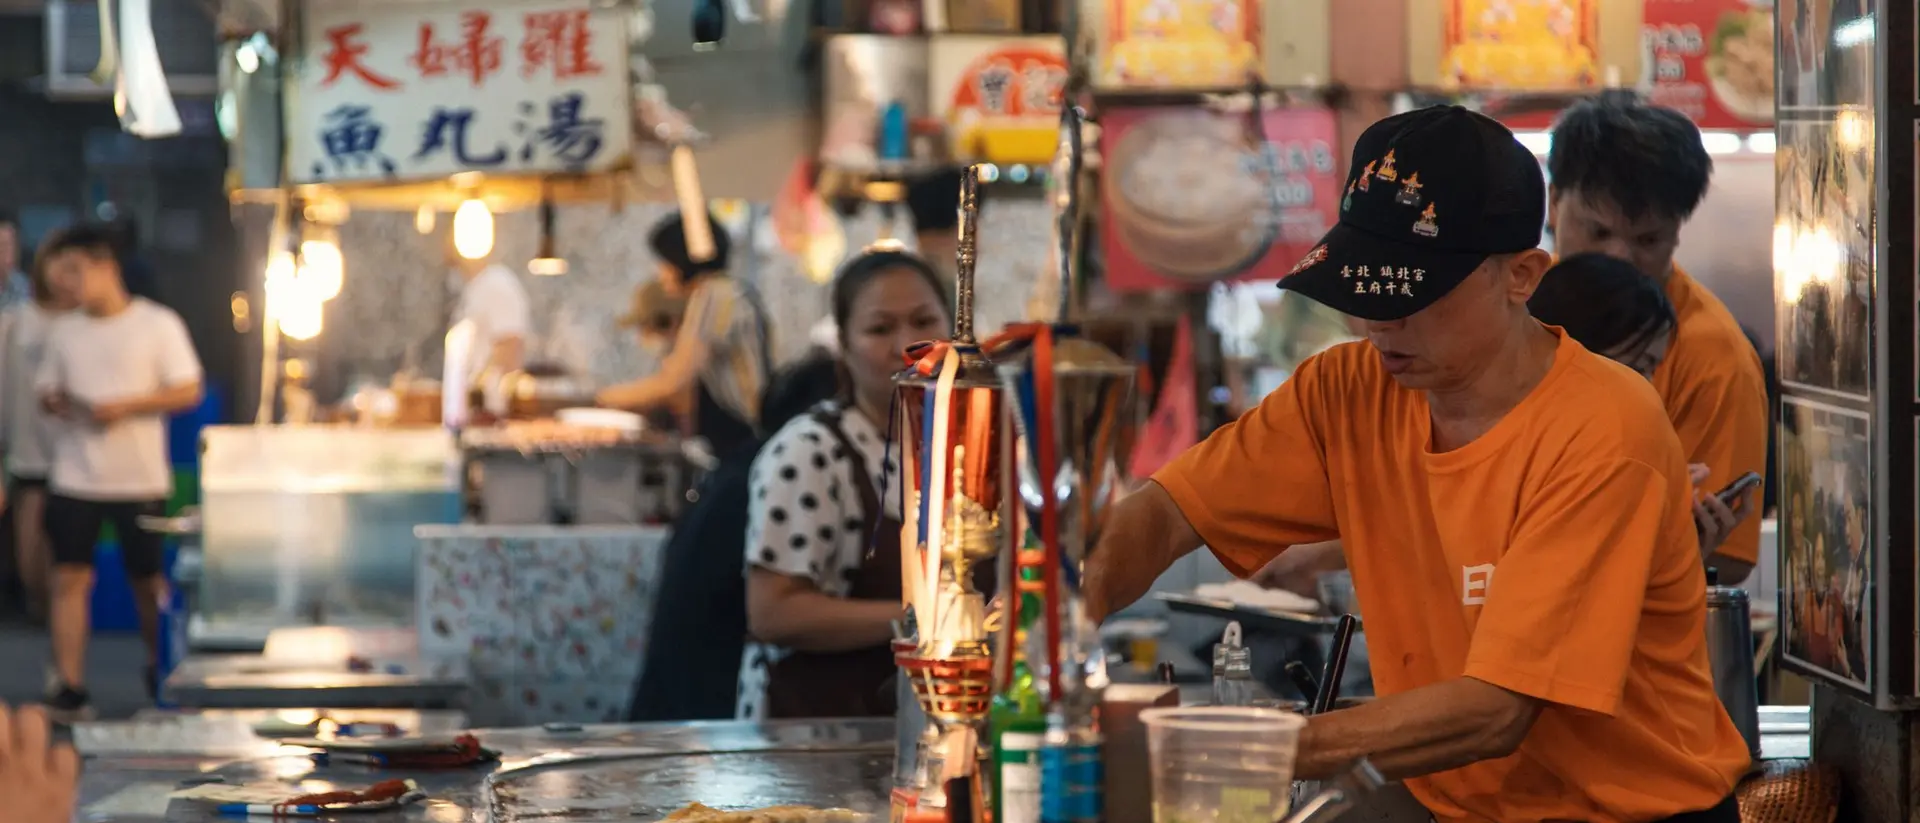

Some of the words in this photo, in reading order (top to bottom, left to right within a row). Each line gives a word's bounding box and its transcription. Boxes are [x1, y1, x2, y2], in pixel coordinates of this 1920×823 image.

[315, 11, 605, 92] 天婦羅
[310, 91, 604, 181] 魚丸湯
[1340, 265, 1370, 278] 臺北
[1380, 265, 1426, 282] 鎮北宮
[1354, 281, 1414, 297] 五府千歲
